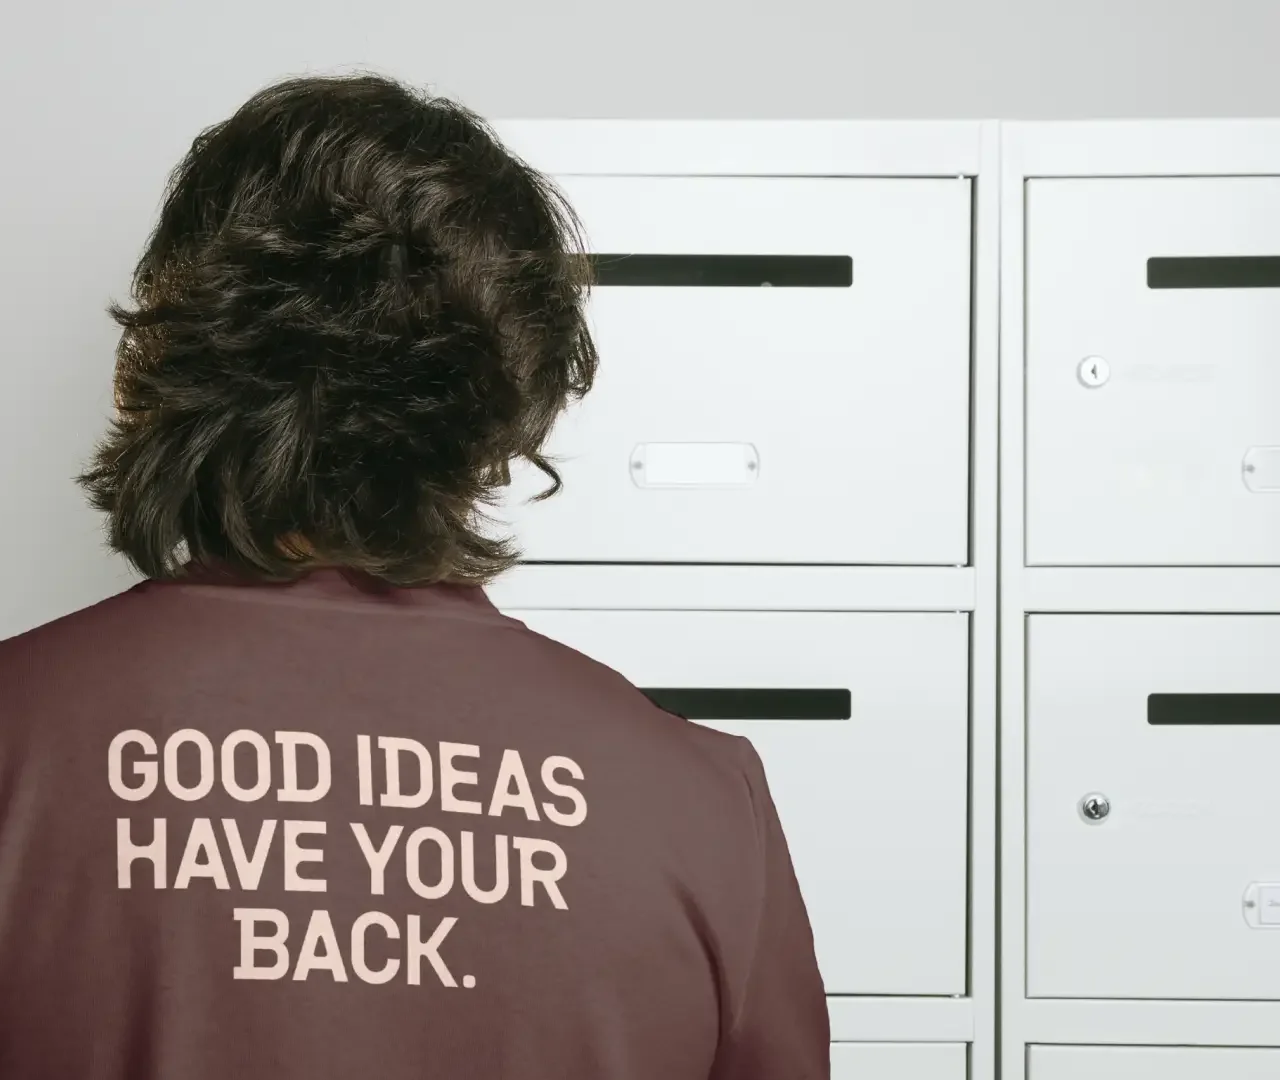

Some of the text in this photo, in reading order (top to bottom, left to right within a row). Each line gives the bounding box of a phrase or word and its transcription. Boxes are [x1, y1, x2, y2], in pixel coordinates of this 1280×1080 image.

[108, 728, 589, 828] GOOD IDEAS
[117, 818, 569, 910] HAVE YOUR
[233, 907, 477, 988] BACK.
